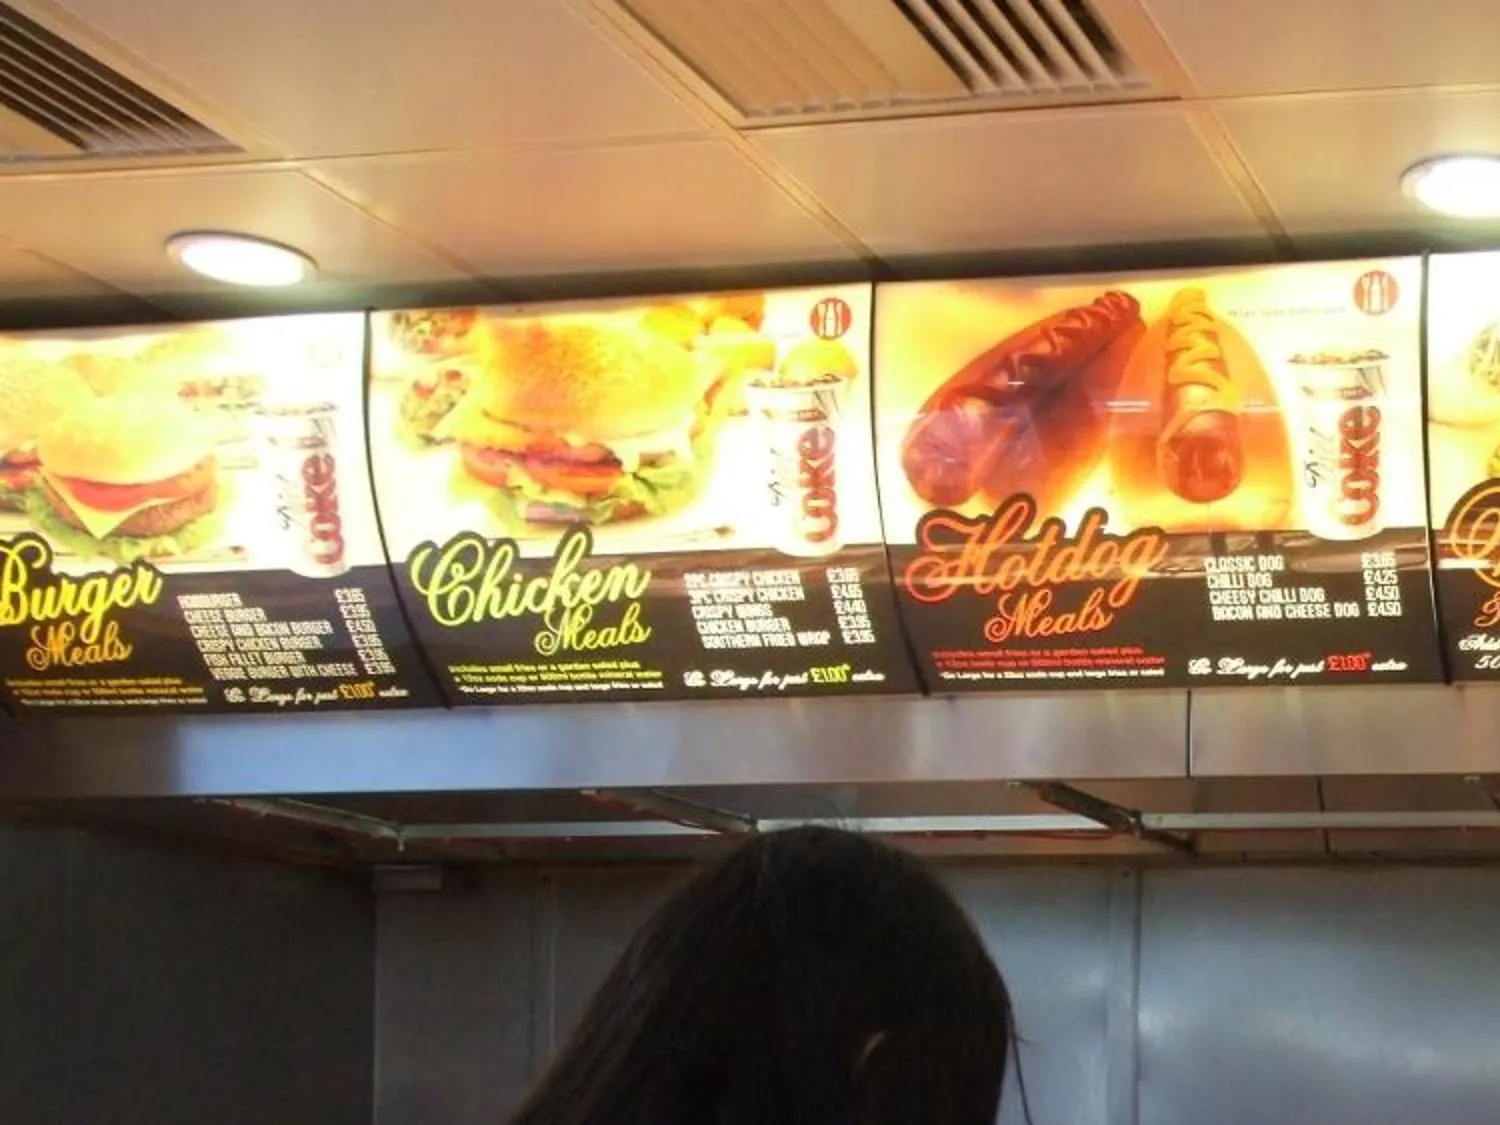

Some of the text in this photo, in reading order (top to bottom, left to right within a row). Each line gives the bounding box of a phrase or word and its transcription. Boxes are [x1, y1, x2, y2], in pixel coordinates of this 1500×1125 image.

[410, 531, 652, 627] Chicken
[905, 501, 1169, 608] Hotdog
[1207, 572, 1273, 588] CHILLI DOG
[1258, 556, 1284, 571] DOG
[0, 540, 163, 644] Burger
[984, 587, 1114, 642] Meals
[1209, 588, 1325, 605] CHEESY CHILLI DOG
[1212, 603, 1360, 621] BACON AND CHEESE DOG
[26, 621, 133, 671] Meals
[534, 602, 652, 656] Meals
